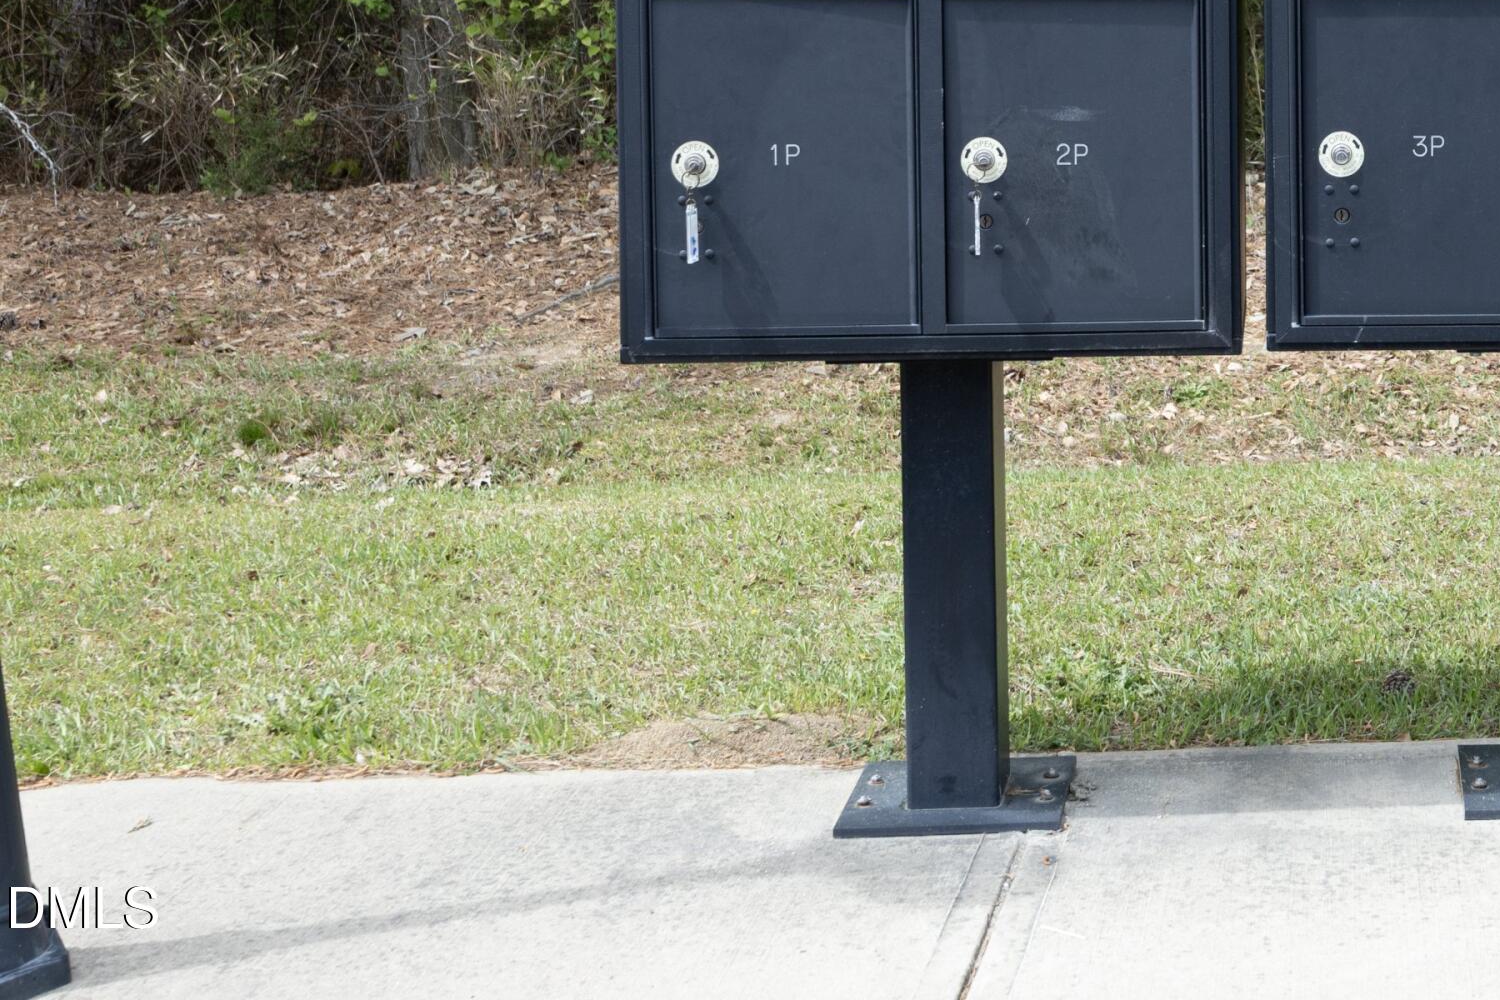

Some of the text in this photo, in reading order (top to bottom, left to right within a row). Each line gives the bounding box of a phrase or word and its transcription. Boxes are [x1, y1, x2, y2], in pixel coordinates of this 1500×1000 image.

[972, 139, 994, 149] OPEN
[1328, 133, 1350, 144] OPEN
[1412, 135, 1445, 158] 3P
[681, 143, 704, 153] OPEN
[770, 143, 801, 166] 1P
[1056, 142, 1089, 166] 2P
